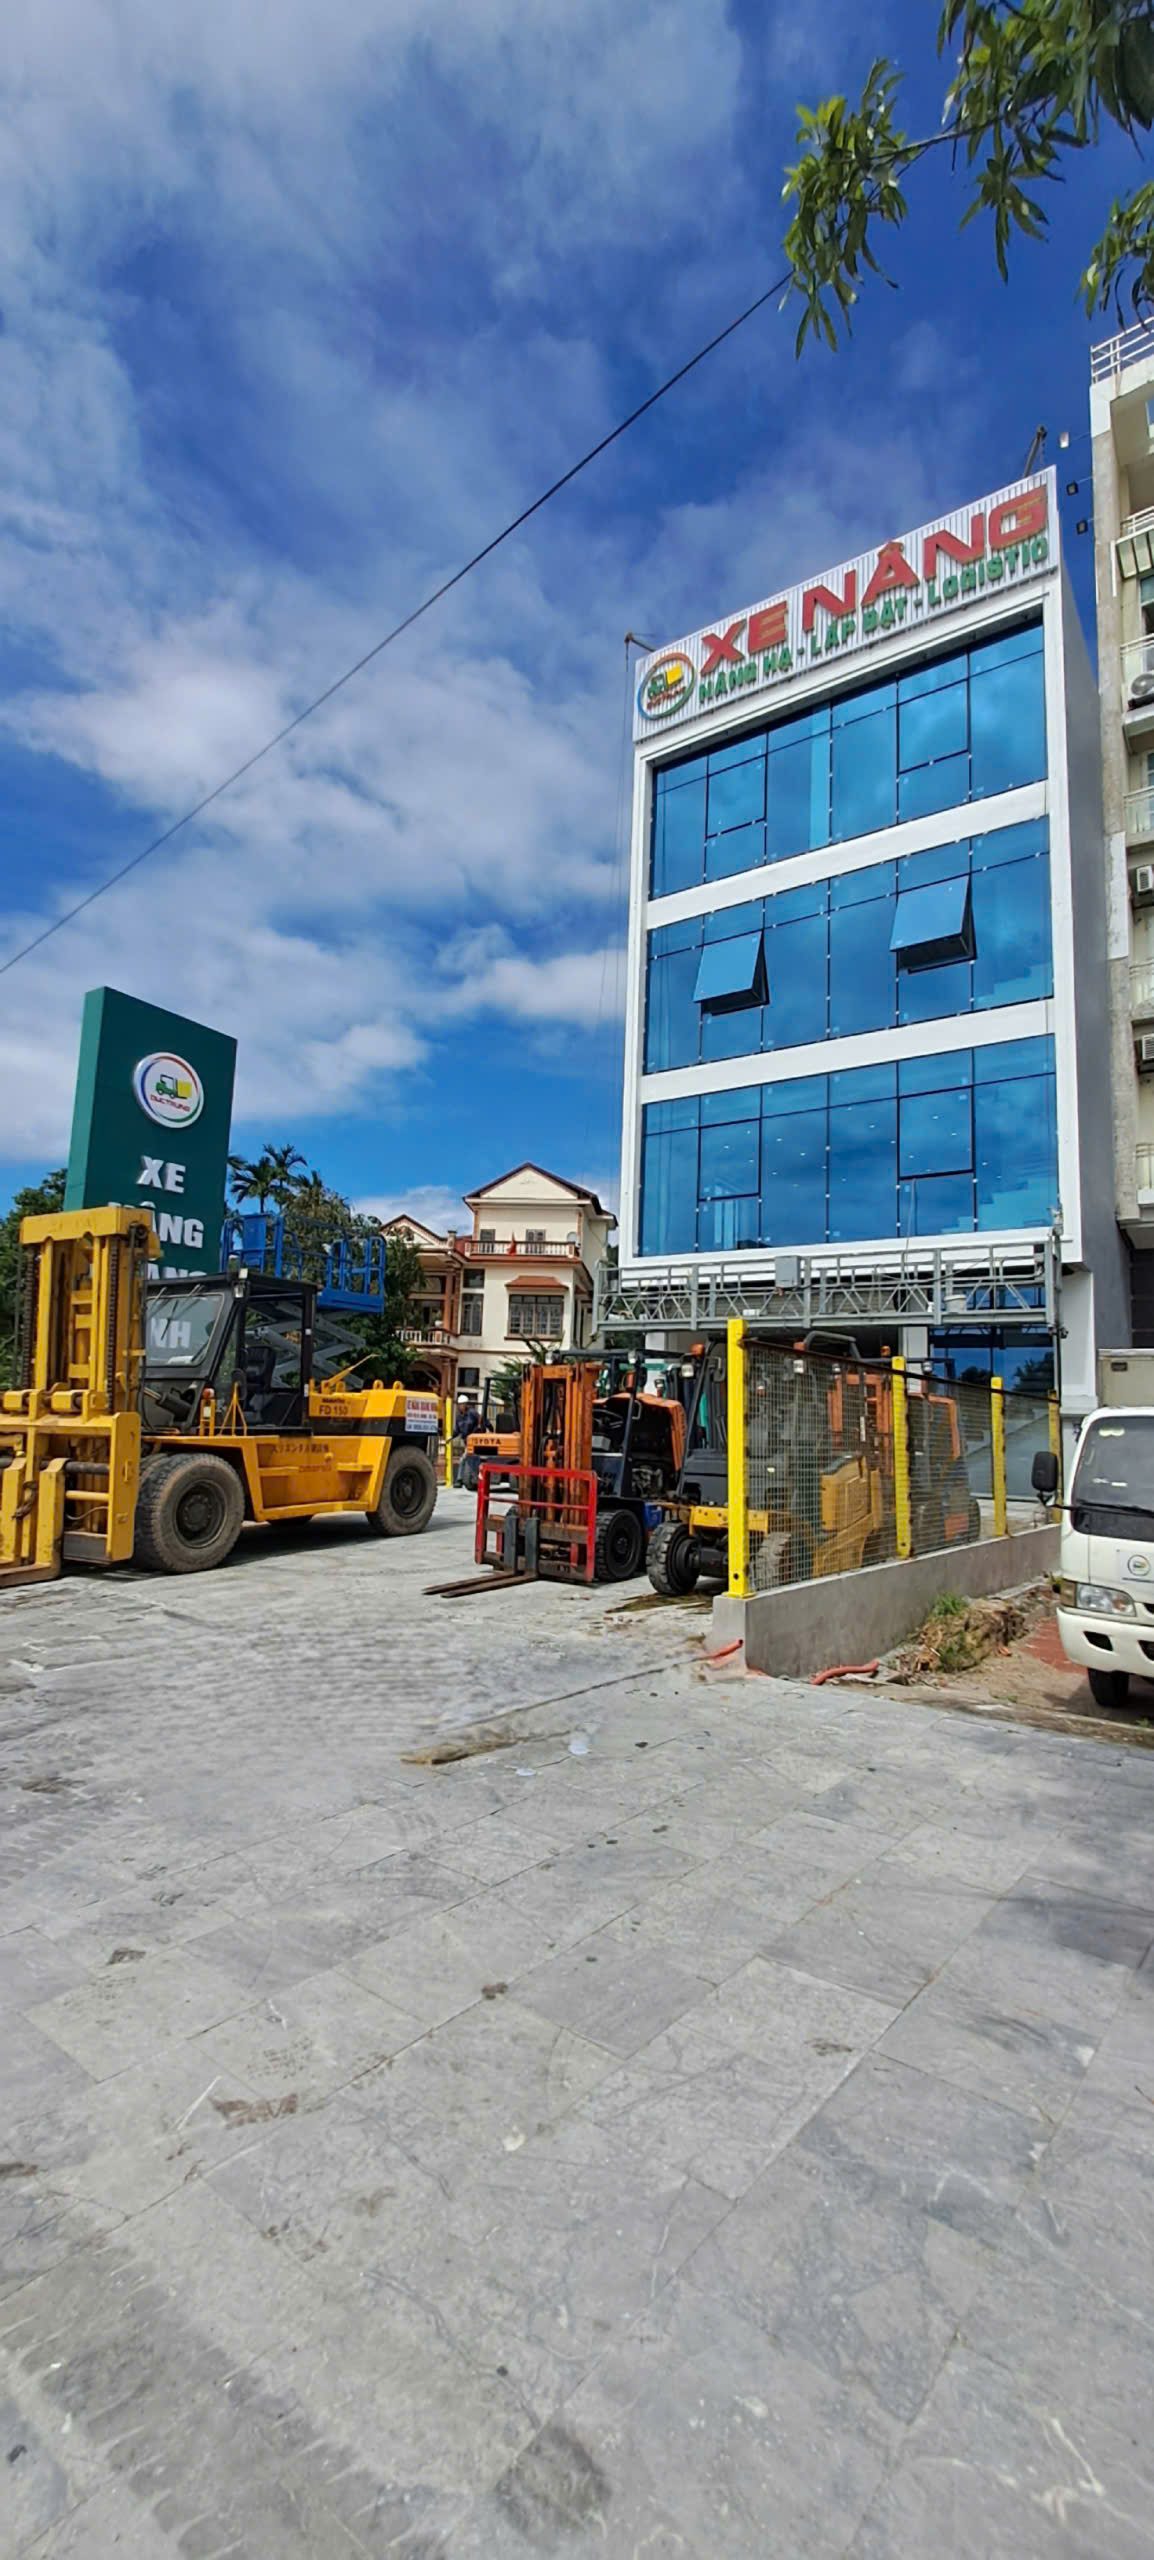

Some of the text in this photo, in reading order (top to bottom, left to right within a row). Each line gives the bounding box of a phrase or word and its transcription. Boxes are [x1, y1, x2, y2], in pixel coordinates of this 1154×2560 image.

[701, 484, 1047, 676] XE NÂNG
[136, 1155, 186, 1194] XE
